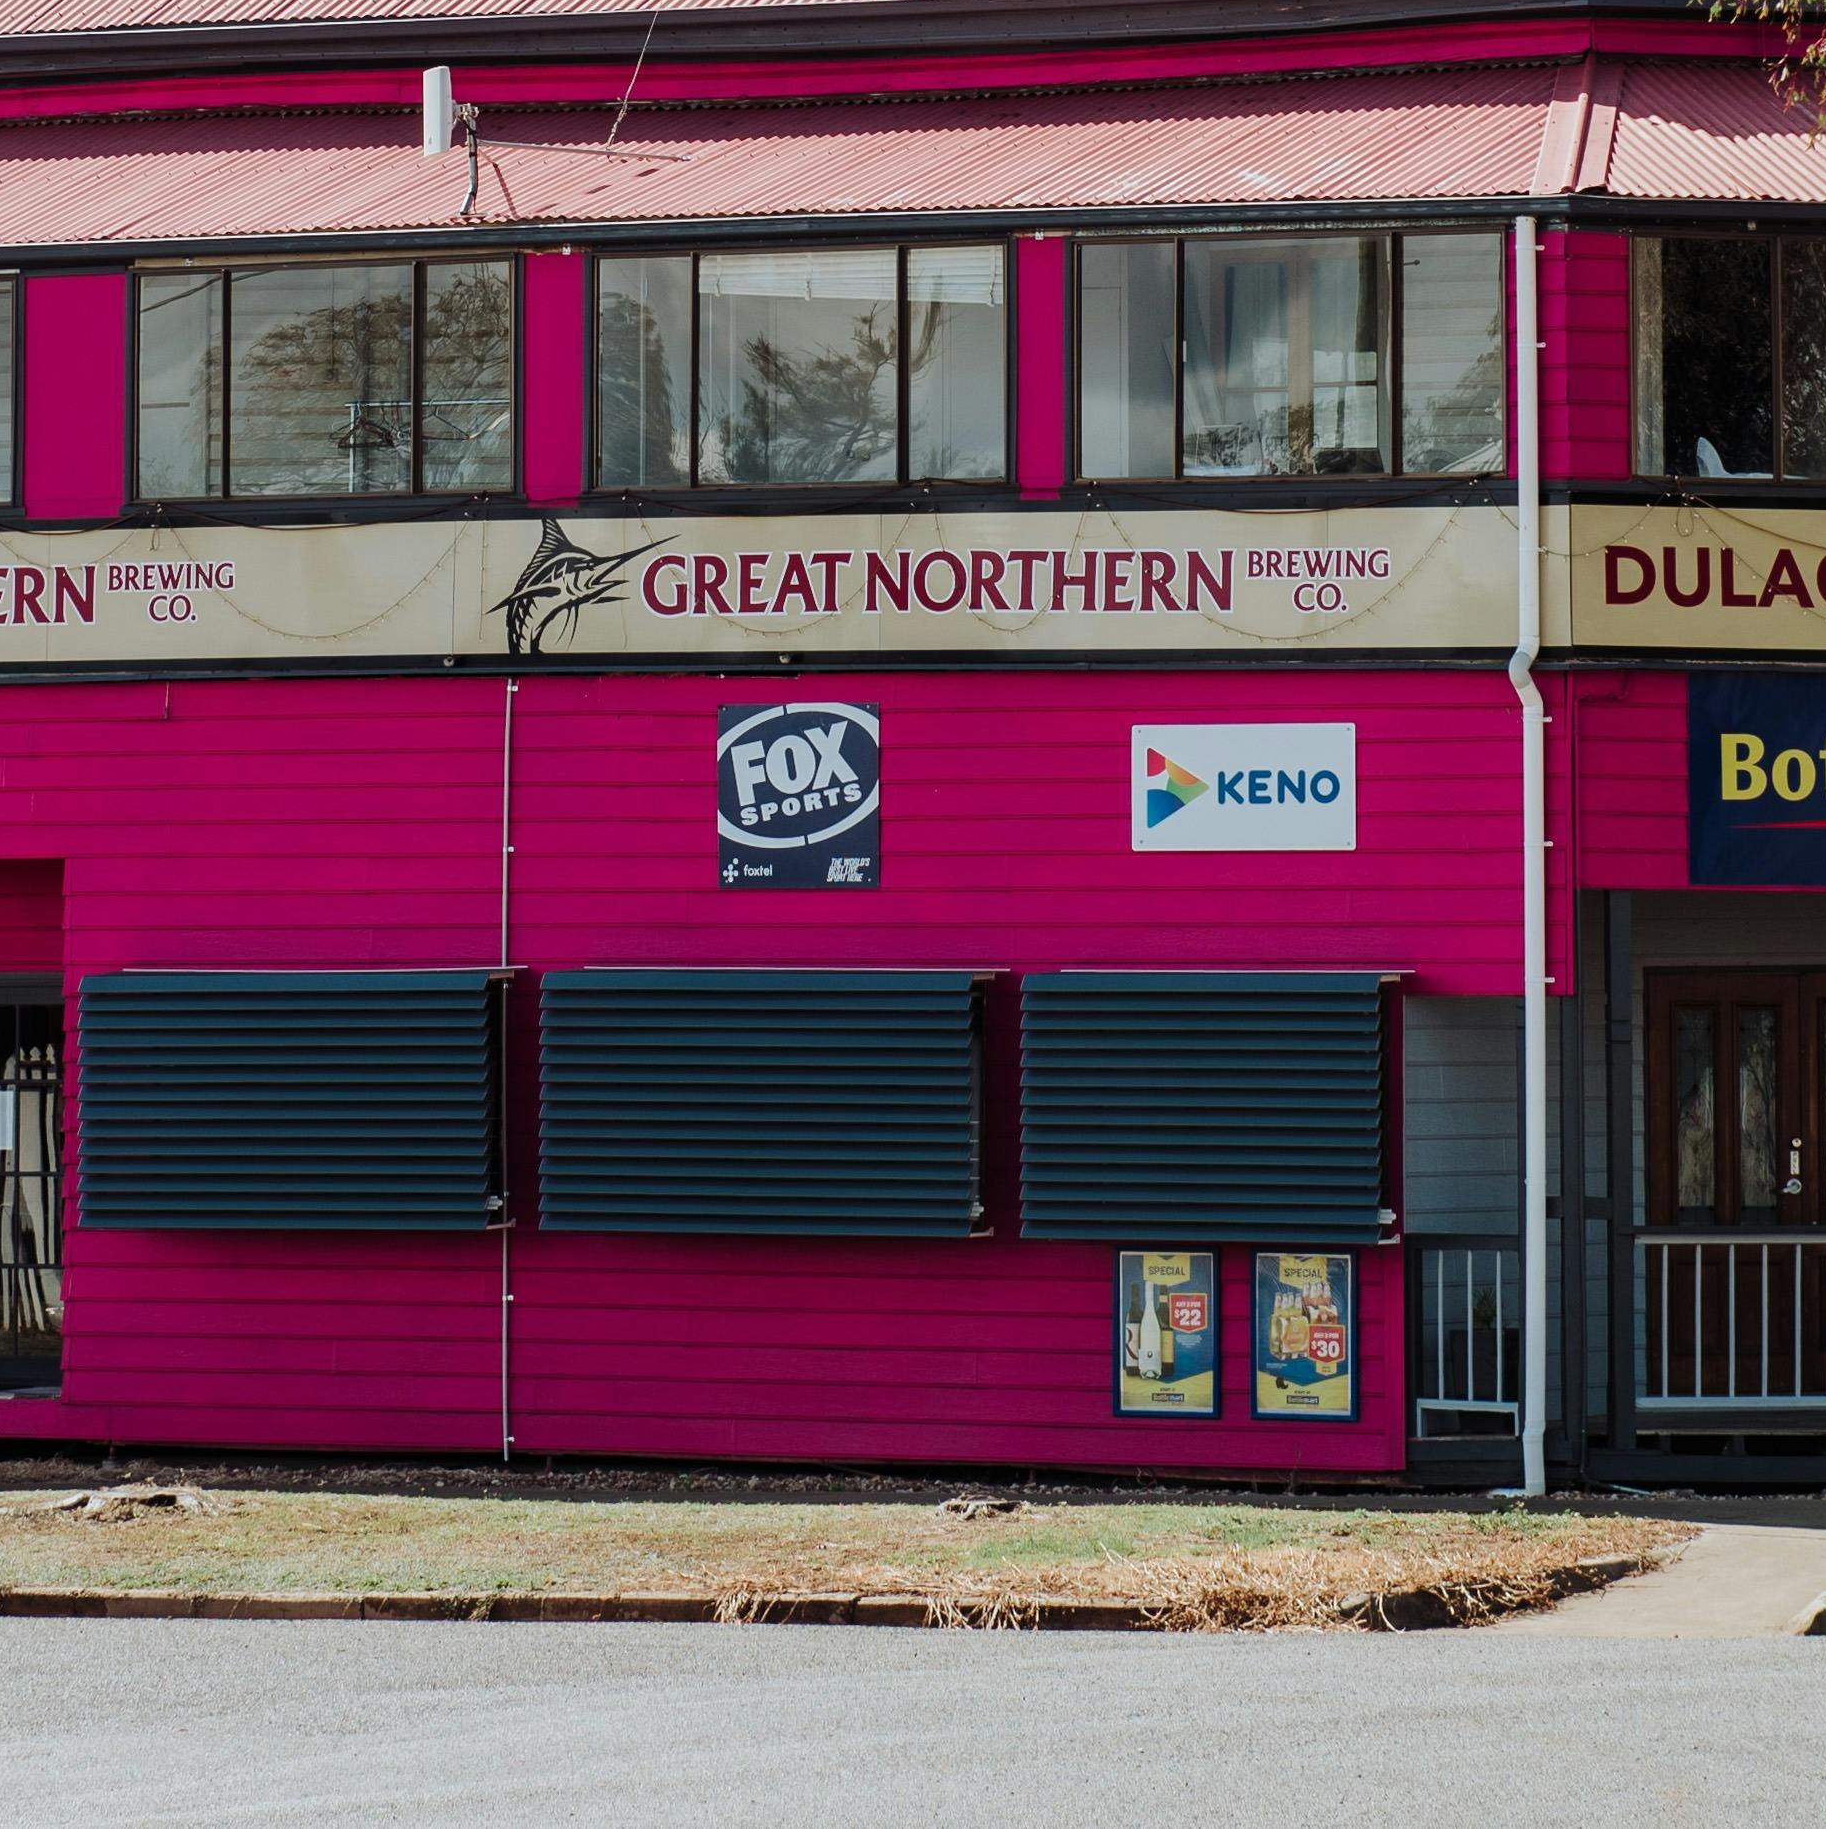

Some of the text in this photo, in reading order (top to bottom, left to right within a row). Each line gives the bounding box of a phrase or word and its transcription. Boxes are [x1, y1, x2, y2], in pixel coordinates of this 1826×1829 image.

[107, 561, 235, 593] BREWING
[1246, 548, 1390, 580] BREWING
[643, 547, 1235, 618] GREAT NORTHERN
[1292, 581, 1349, 613] CO.
[147, 594, 199, 624] CO.
[731, 721, 859, 807] FOX
[1218, 769, 1341, 806] KENO
[740, 783, 862, 826] SPORTS
[743, 863, 773, 877] foxtel
[1148, 1266, 1186, 1276] SPECIAL
[1284, 1267, 1323, 1279] SPECIAL
[1174, 1308, 1201, 1327] $22
[1311, 1339, 1340, 1358] $30
